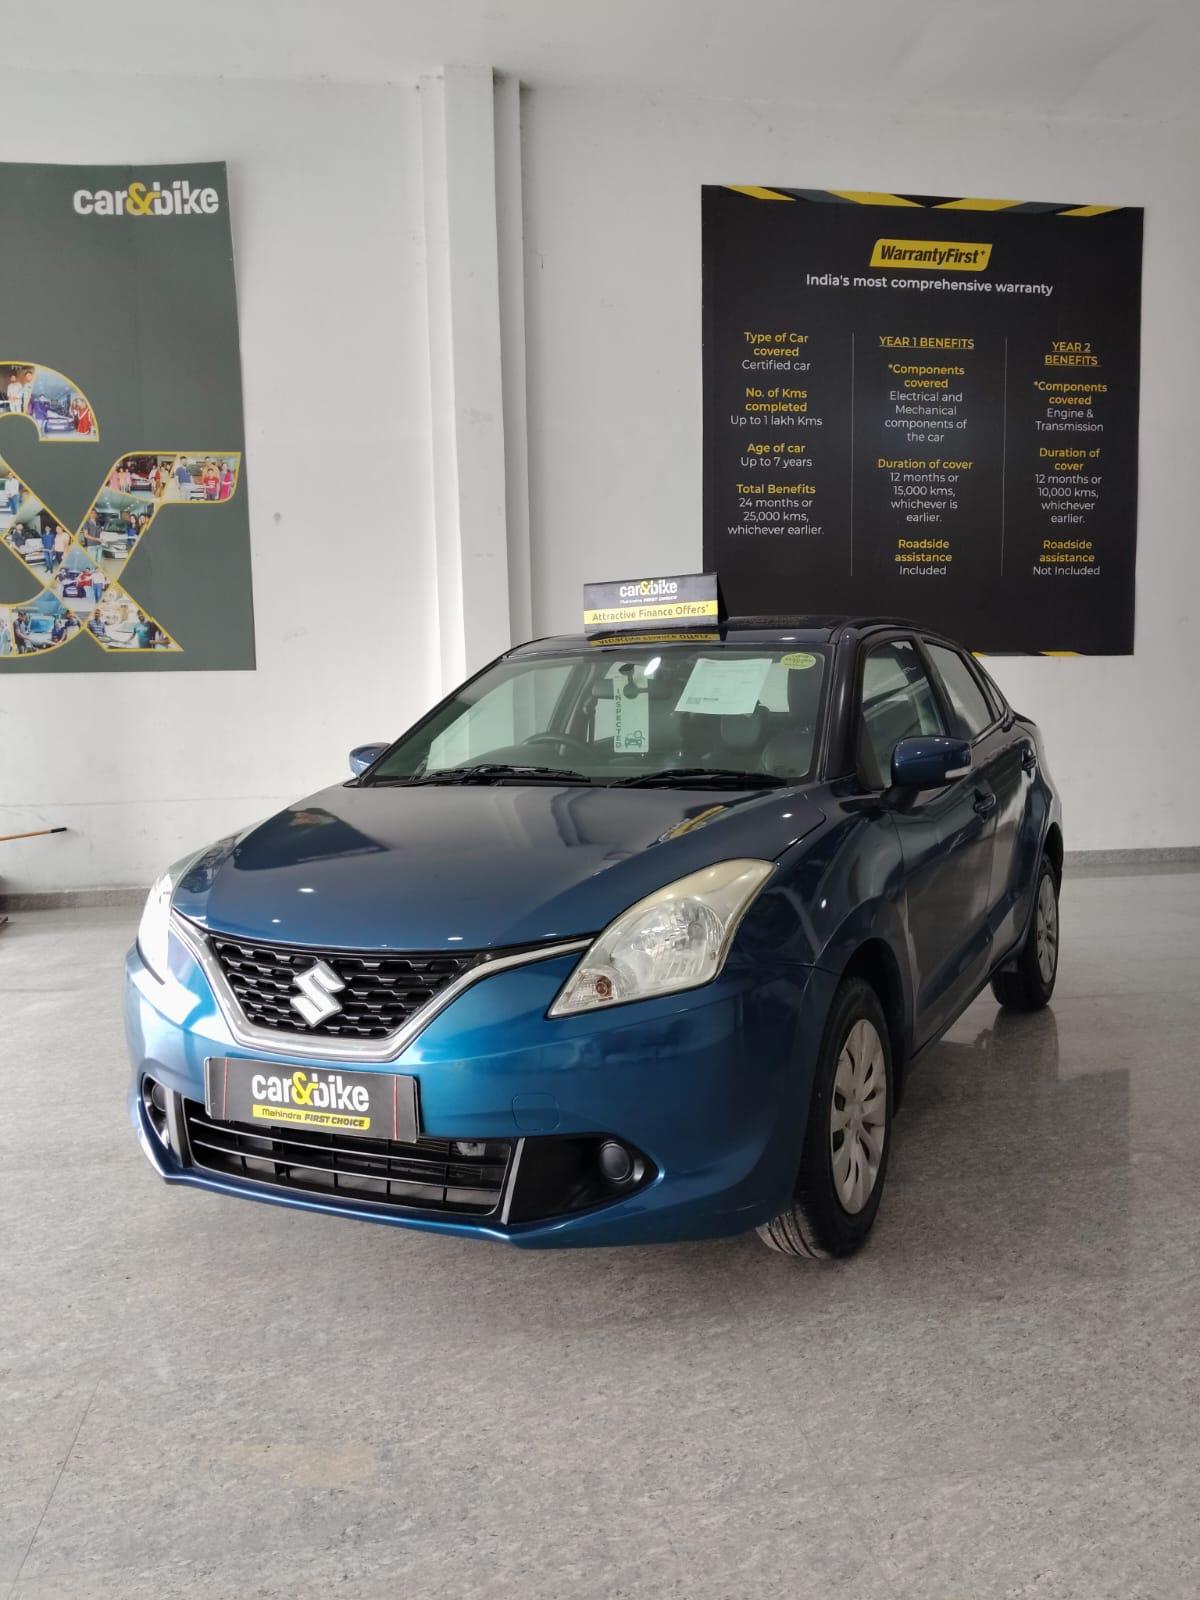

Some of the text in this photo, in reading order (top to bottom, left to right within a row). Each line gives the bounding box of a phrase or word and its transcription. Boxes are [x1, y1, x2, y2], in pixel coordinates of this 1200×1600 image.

[73, 180, 219, 217] car&bike
[807, 274, 1053, 296] India's most comprehensive warranty
[744, 332, 808, 344] Type of Car
[880, 336, 910, 348] YEAR
[920, 338, 974, 350] BENEFITS
[754, 347, 799, 356] covered
[1052, 341, 1081, 352] YEAR
[742, 360, 790, 370] Certified
[1045, 355, 1097, 366] BENEFITS
[904, 379, 948, 388] covered
[746, 388, 807, 398] No. of Kms
[890, 391, 962, 402] Electrical and
[1049, 396, 1091, 405] covered
[746, 402, 807, 413] completed
[896, 405, 956, 415] Mechanical
[1047, 408, 1084, 420] Engine
[731, 416, 746, 427] Up
[750, 416, 761, 424] to
[771, 415, 794, 425] lakh
[798, 416, 822, 425] Kms
[885, 419, 967, 430] components of
[1035, 421, 1103, 431] Transmission
[907, 432, 944, 442] the car
[747, 443, 770, 454] Age
[773, 443, 785, 452] of
[1040, 448, 1100, 458] Duration of
[741, 457, 757, 468] Up
[760, 458, 771, 466] to
[782, 459, 812, 468] years
[878, 459, 925, 468] Duration
[929, 459, 940, 469] of
[891, 472, 900, 481] 12
[904, 473, 945, 482] months
[1035, 474, 1045, 483] 12
[1048, 474, 1088, 484] months
[736, 484, 816, 494] Total Benefits
[893, 486, 955, 497] 15,000 kms,
[1038, 487, 1098, 498] 10,000 kms,
[739, 498, 752, 507] 24
[756, 498, 799, 507] months
[891, 499, 958, 509] whichever is
[1041, 501, 1095, 510] whichever
[744, 512, 808, 522] 25,000 kms,
[906, 512, 942, 522] earlier.
[1051, 514, 1085, 523] earlier.
[728, 525, 824, 534] whichever earlier.
[899, 539, 949, 548] Roadside
[1044, 540, 1092, 549] Roadside
[895, 552, 952, 561] assistance
[1040, 553, 1095, 562] assistance
[900, 565, 946, 575] Included
[1033, 566, 1100, 575] Not Included
[619, 579, 678, 597] car&bike
[592, 610, 636, 622] Attractive
[639, 607, 673, 618] Finance
[252, 1071, 369, 1112] car&bike
[262, 1107, 365, 1128] Mahindra FIRST CHOICE
